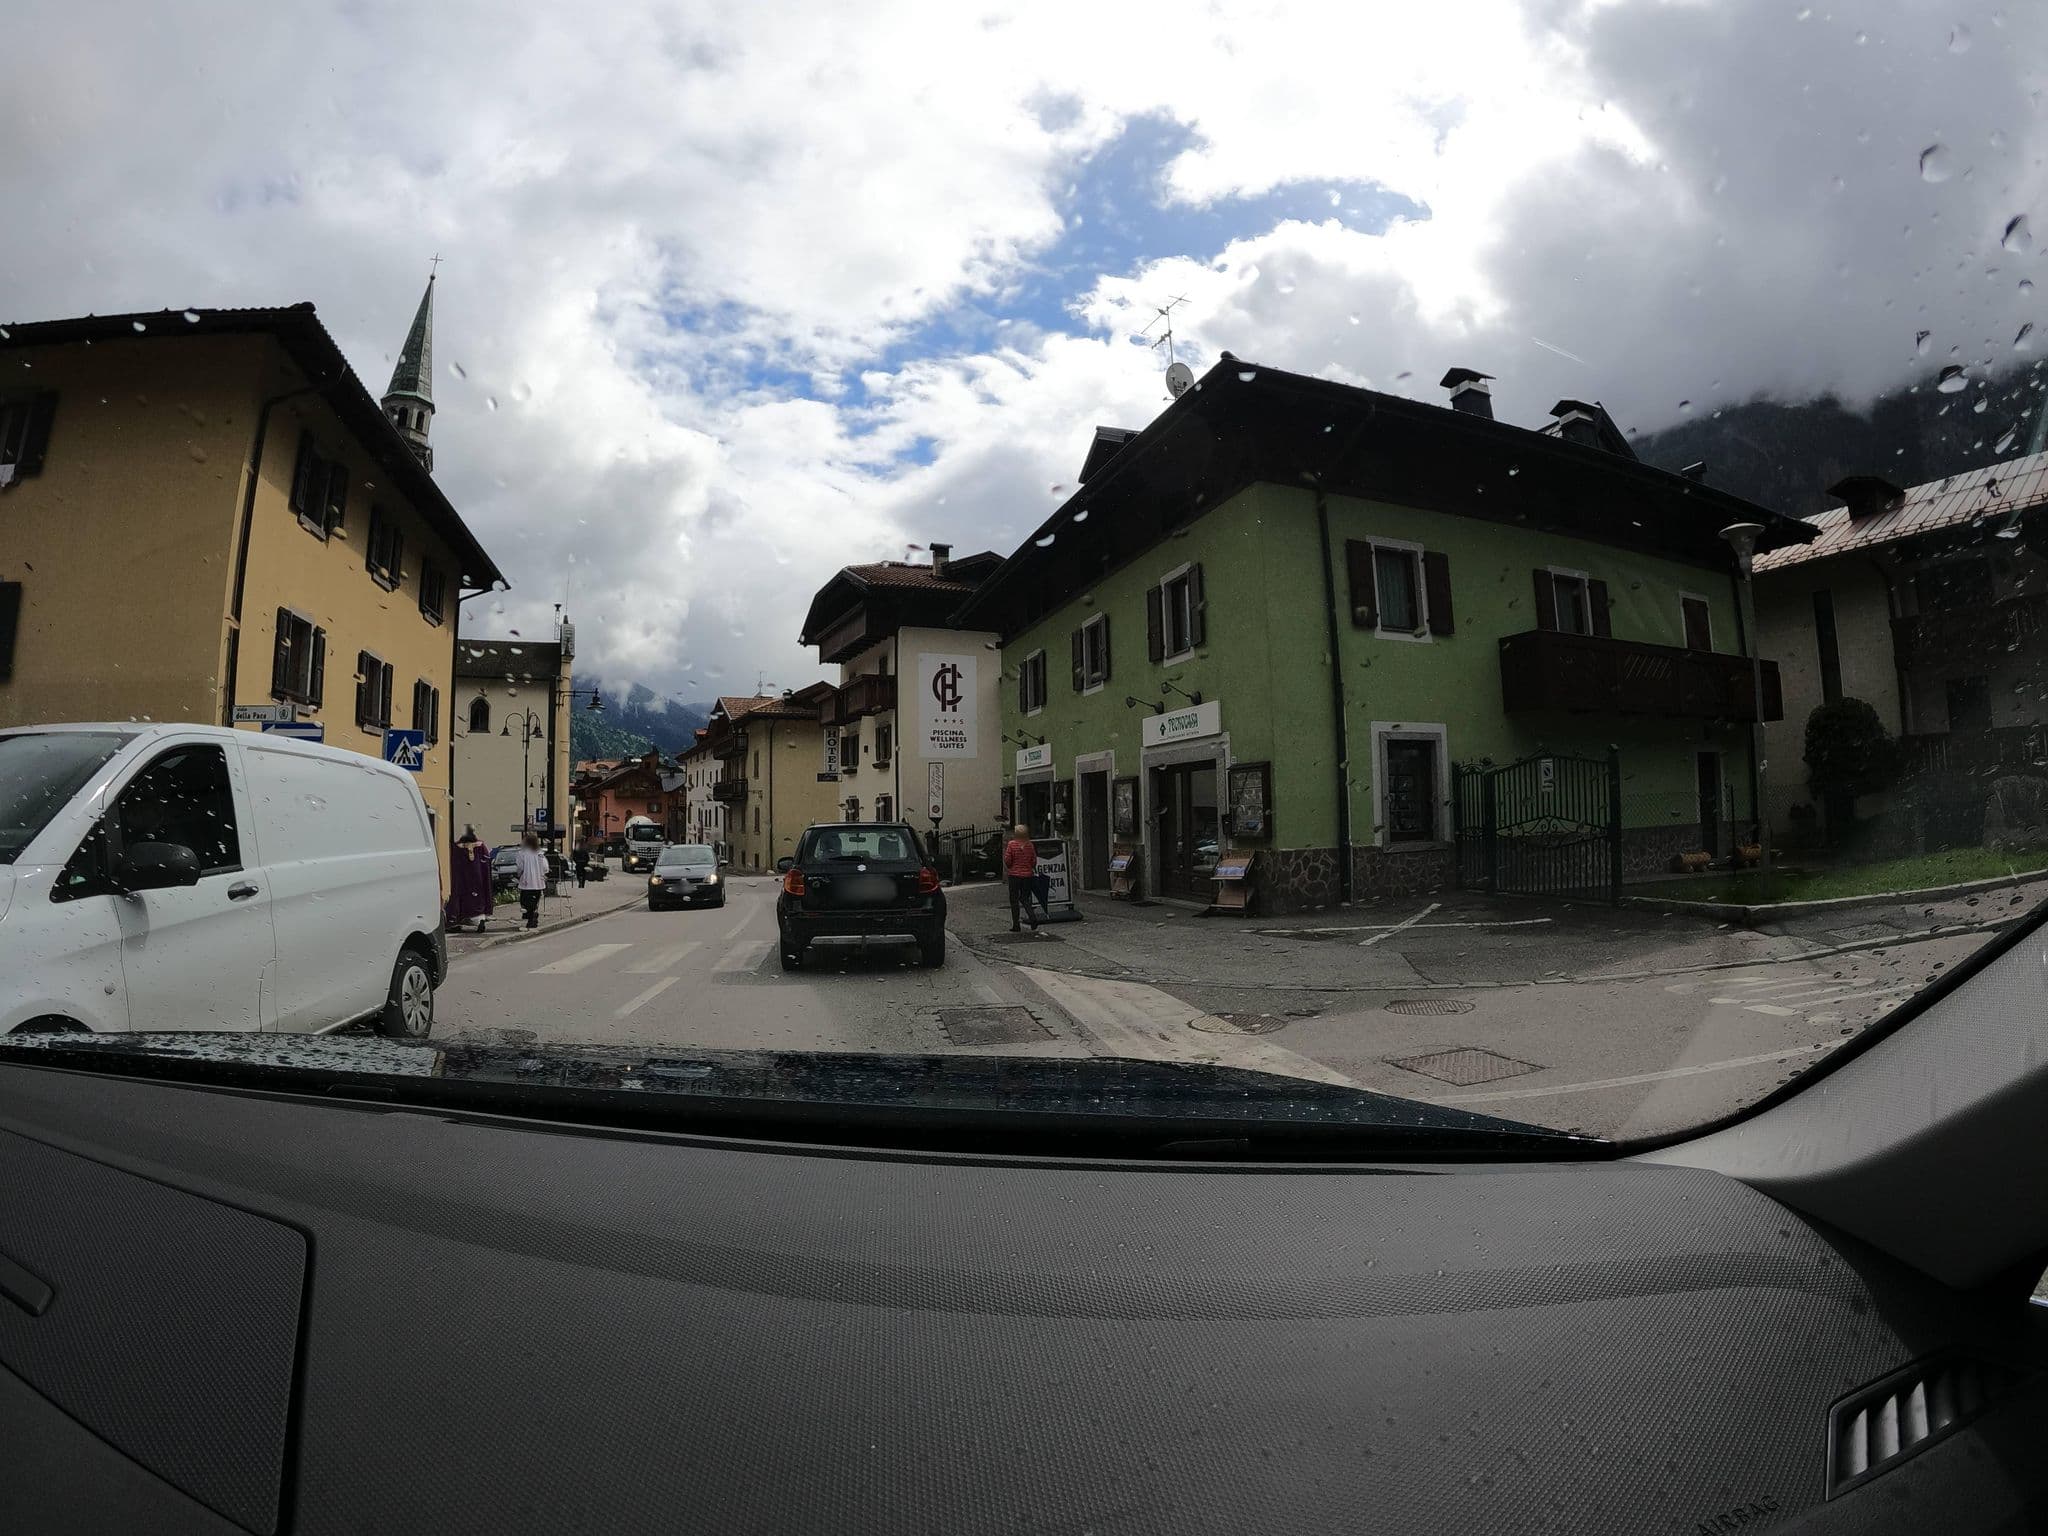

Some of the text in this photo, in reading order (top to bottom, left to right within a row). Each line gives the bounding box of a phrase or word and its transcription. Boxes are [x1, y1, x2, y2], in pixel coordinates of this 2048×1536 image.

[236, 712, 267, 720] della Pace
[827, 730, 837, 771] HOTEL
[538, 810, 547, 820] P
